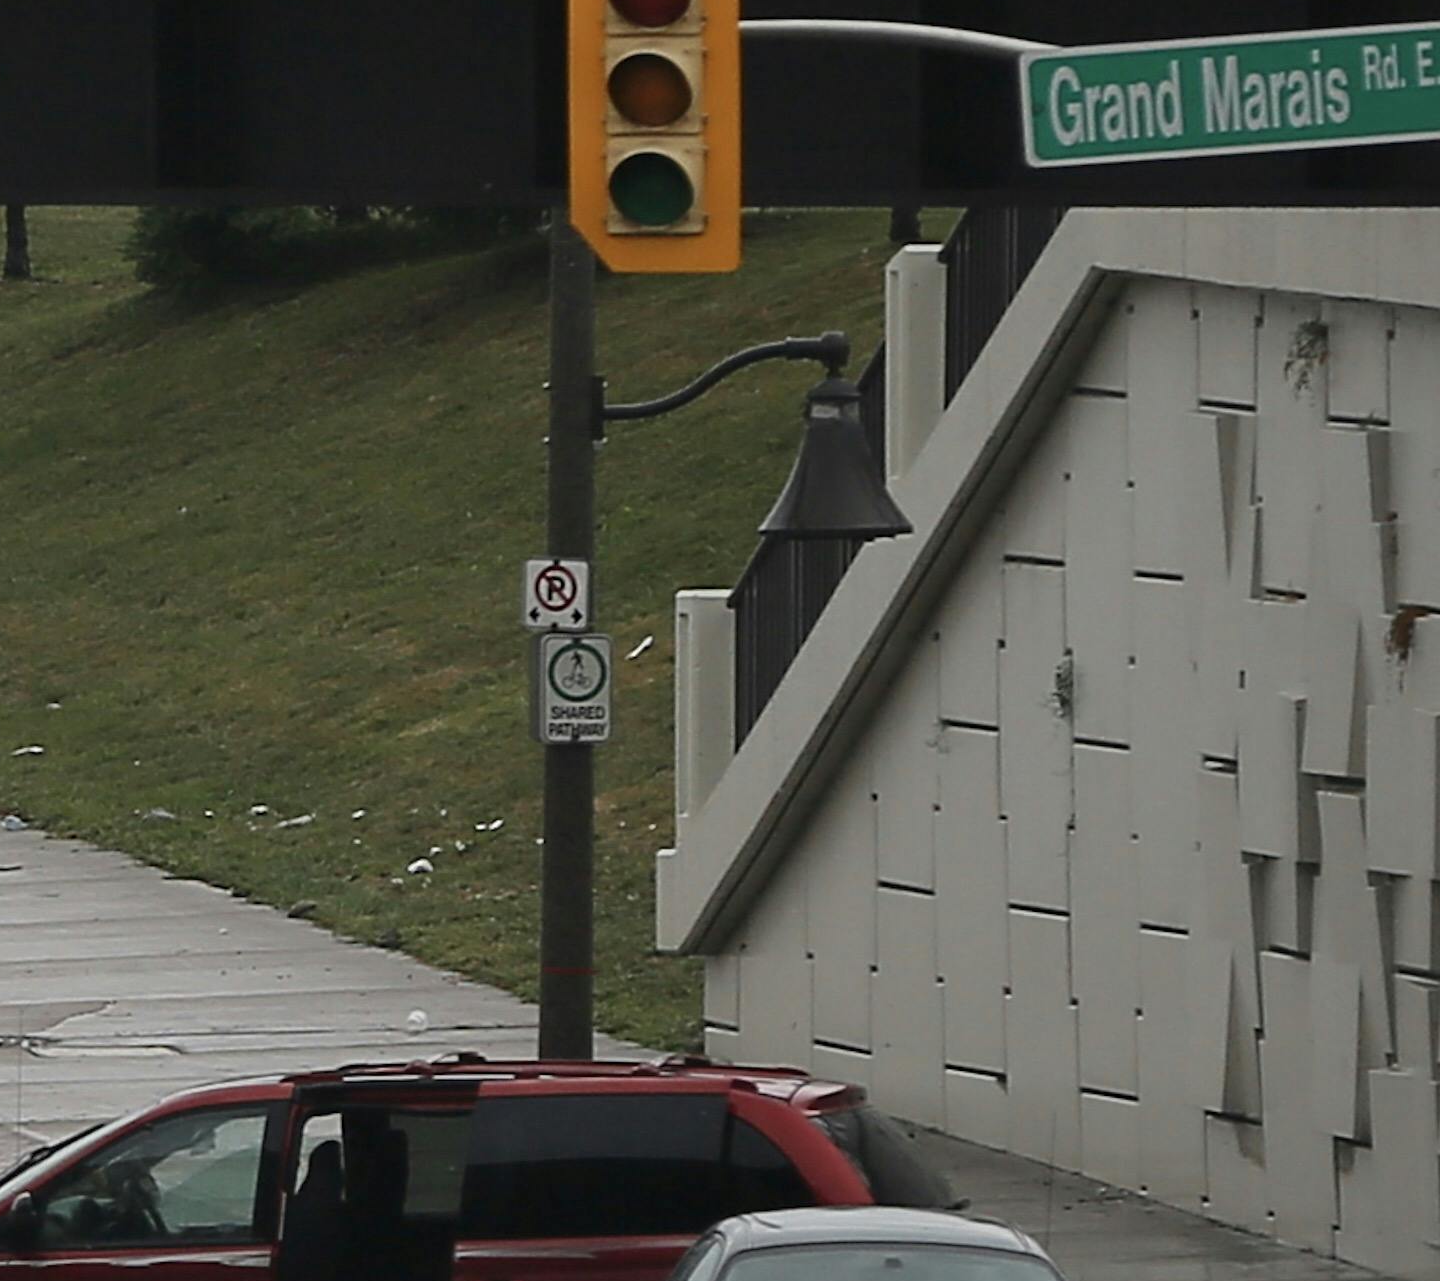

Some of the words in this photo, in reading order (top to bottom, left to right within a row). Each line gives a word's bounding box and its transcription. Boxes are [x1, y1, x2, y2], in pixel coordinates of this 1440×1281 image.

[1048, 60, 1185, 147] Grand
[1202, 48, 1352, 134] Marais
[1363, 44, 1407, 91] Rd.
[551, 706, 605, 720] SHARED
[549, 722, 608, 737] PATHWAY
